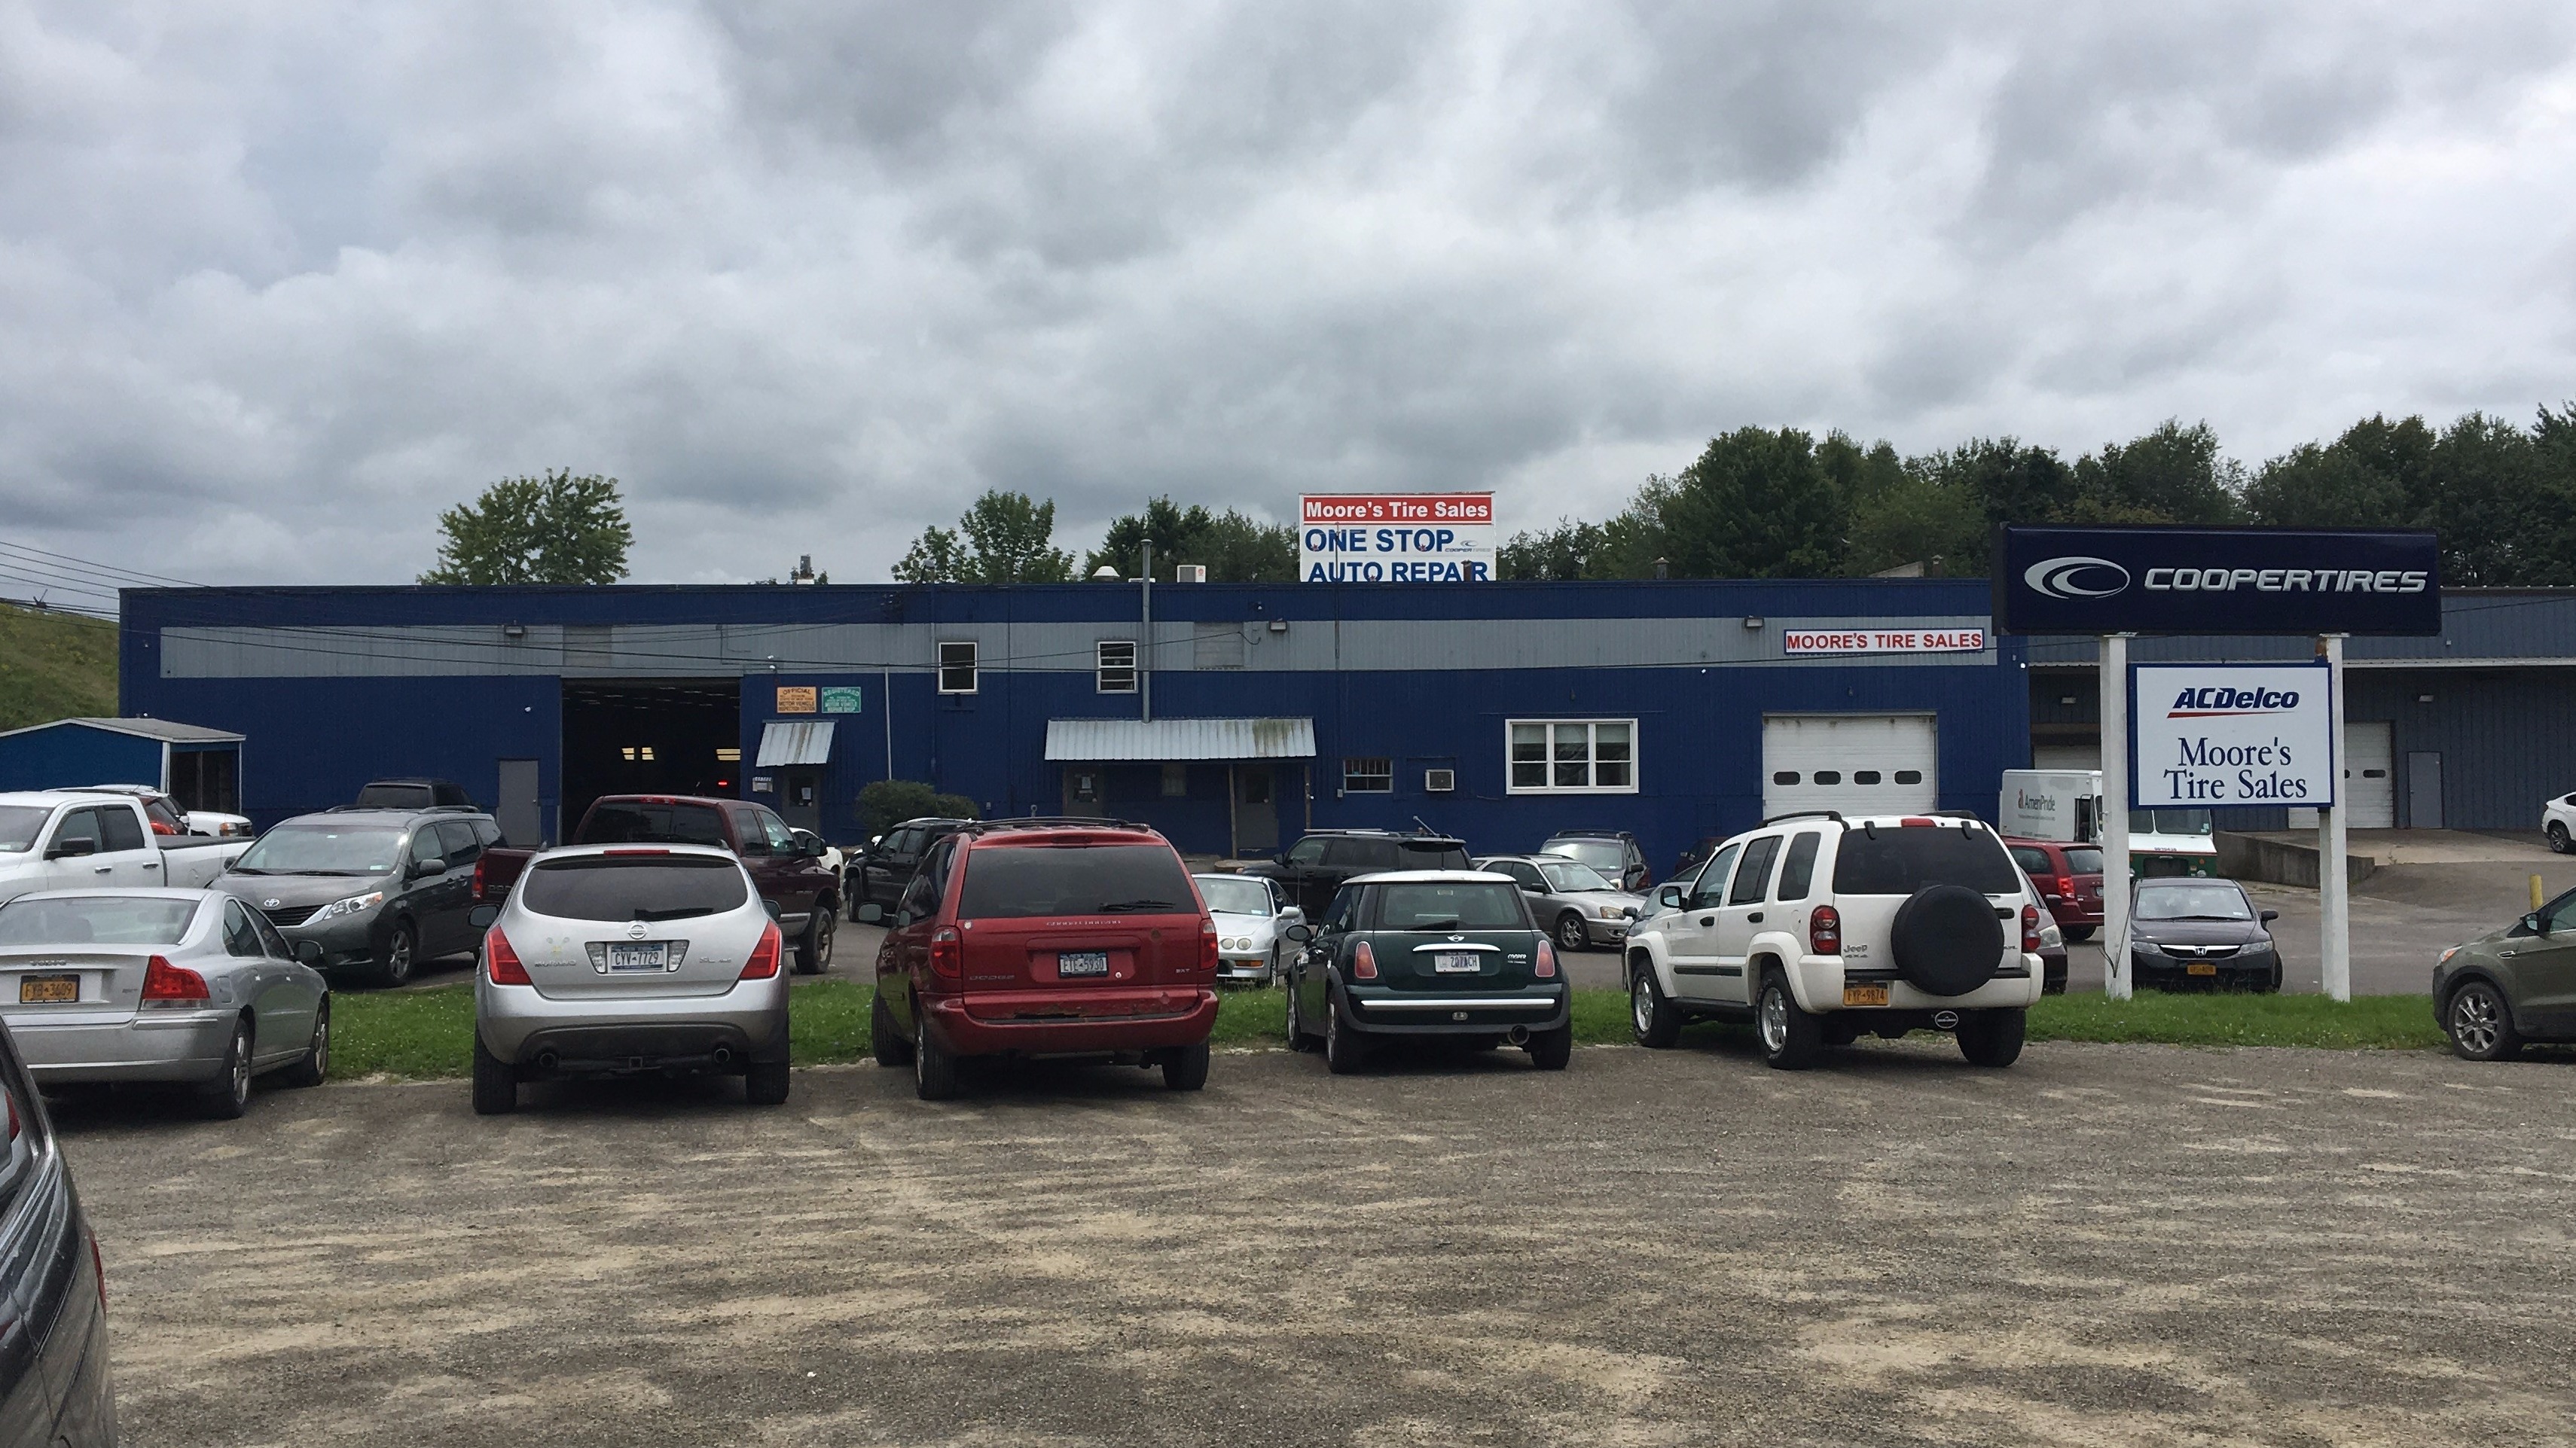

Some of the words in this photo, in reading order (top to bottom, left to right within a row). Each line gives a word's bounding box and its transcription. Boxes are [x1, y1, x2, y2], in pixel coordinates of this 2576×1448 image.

[1306, 501, 1383, 517] Moore's
[1389, 501, 1428, 517] Tire
[1435, 501, 1488, 517] Sales
[1305, 529, 1367, 552] ONE
[1376, 529, 1454, 552] STOP
[1308, 562, 1383, 583] AUTO
[1391, 562, 1488, 582] REPAR
[1787, 633, 1868, 649] MOORE'S
[1875, 634, 1915, 648] TIRE
[1923, 633, 1982, 648] SALES
[2178, 736, 2292, 767] Moore's
[2163, 769, 2225, 800] Tire
[2238, 770, 2307, 800] Sales
